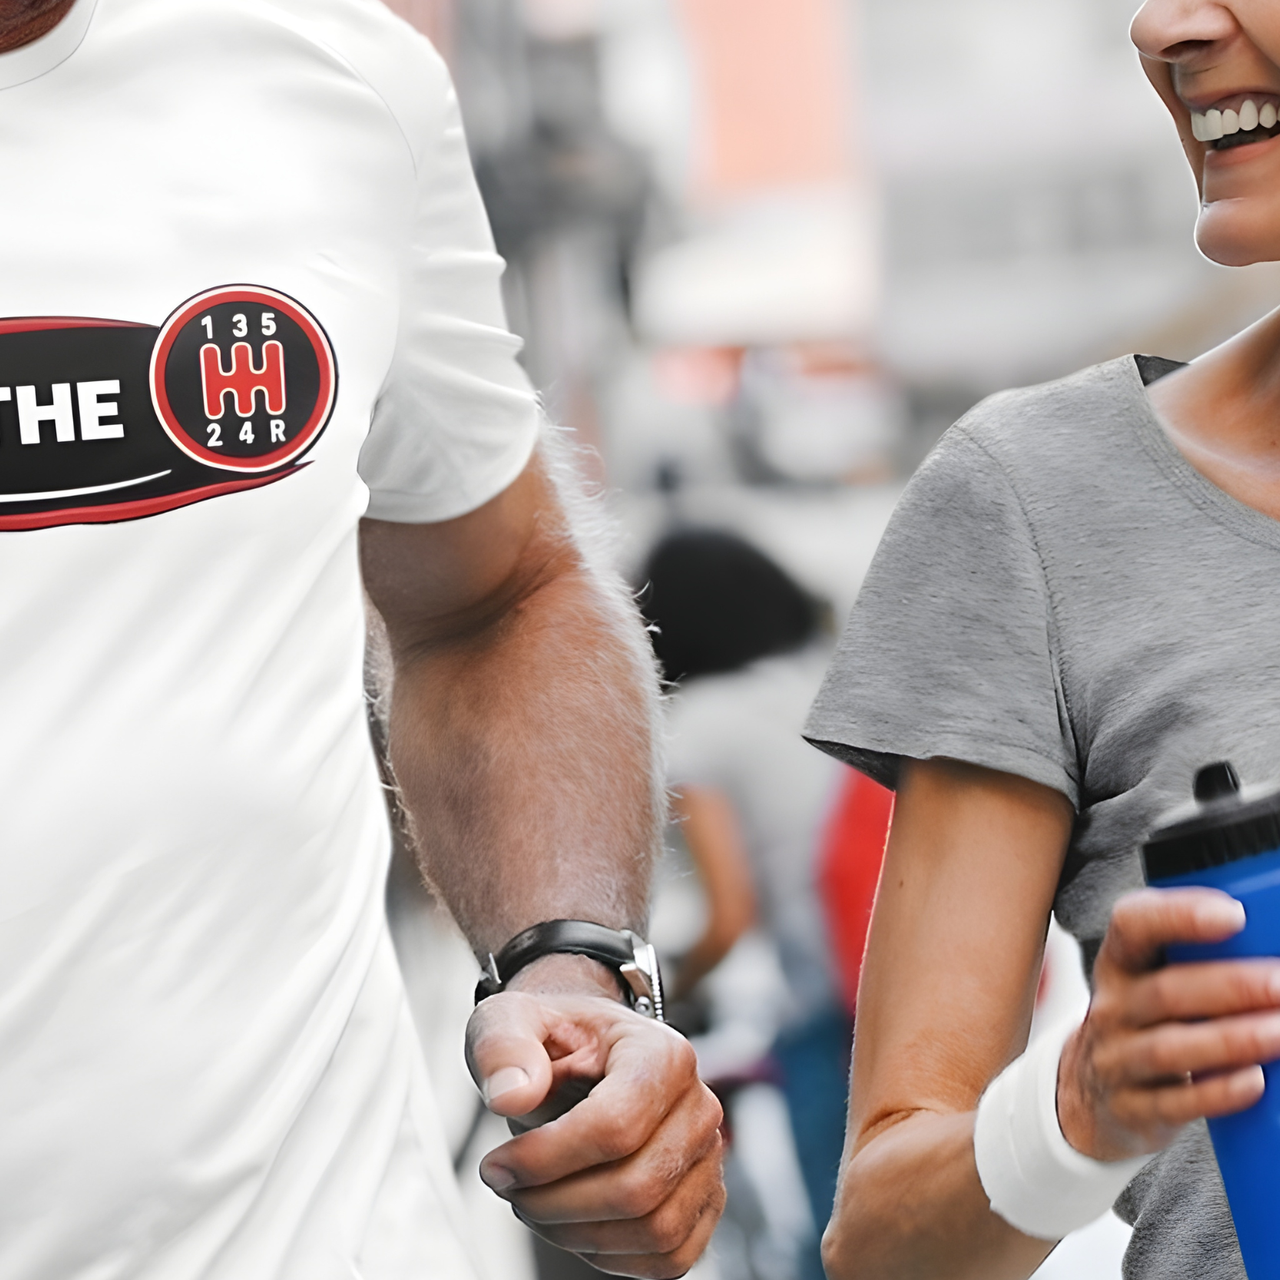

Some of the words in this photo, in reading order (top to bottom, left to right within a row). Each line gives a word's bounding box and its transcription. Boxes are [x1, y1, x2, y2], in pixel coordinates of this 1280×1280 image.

[200, 314, 214, 340] 1
[231, 313, 248, 338] 3
[260, 311, 277, 337] 5
[206, 422, 224, 448] 2
[238, 420, 255, 445] 4
[269, 418, 287, 444] R
